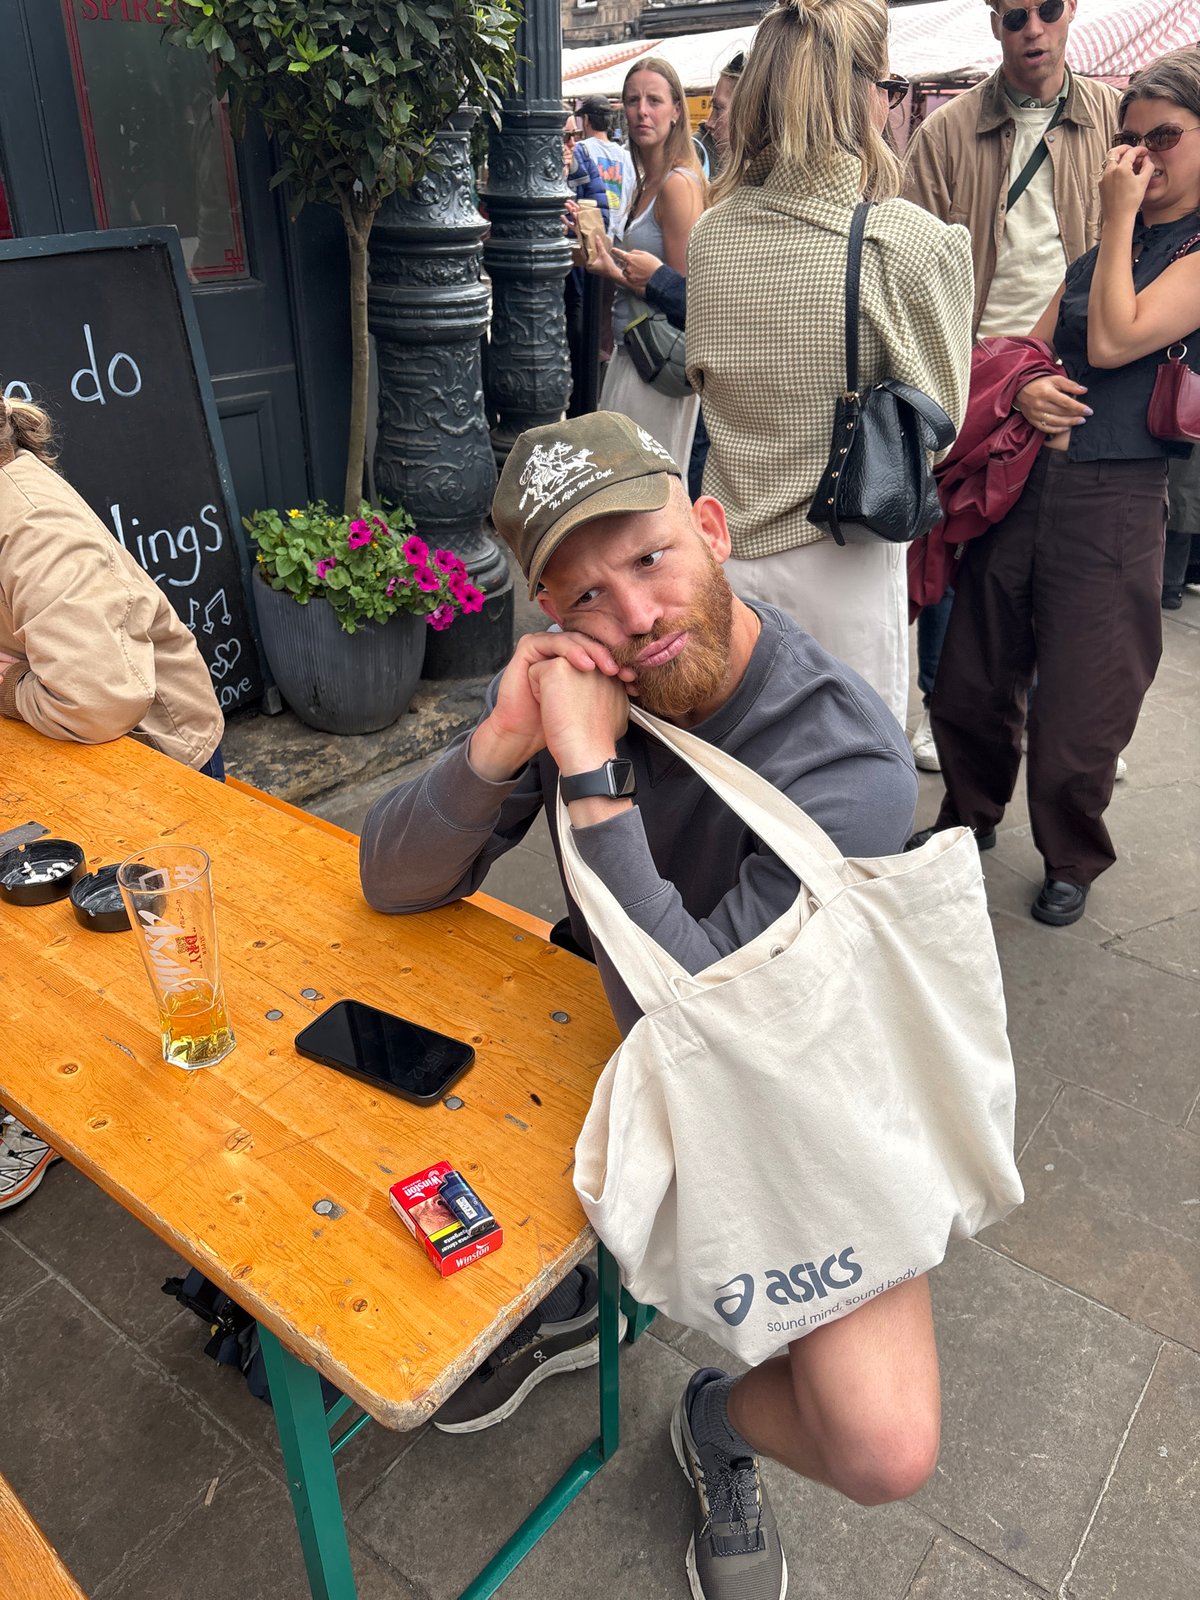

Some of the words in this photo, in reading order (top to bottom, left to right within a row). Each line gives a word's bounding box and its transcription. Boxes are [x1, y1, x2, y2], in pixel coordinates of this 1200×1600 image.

[71, 323, 142, 405] do
[549, 498, 561, 511] The
[561, 485, 578, 503] After
[214, 677, 252, 707] ove
[137, 909, 196, 992] Asahi
[403, 1175, 443, 1197] Winston
[455, 1245, 490, 1268] Winston
[767, 1315, 806, 1332] sound
[809, 1302, 842, 1325] mind,
[844, 1283, 884, 1306] sound
[886, 1267, 918, 1289] body
